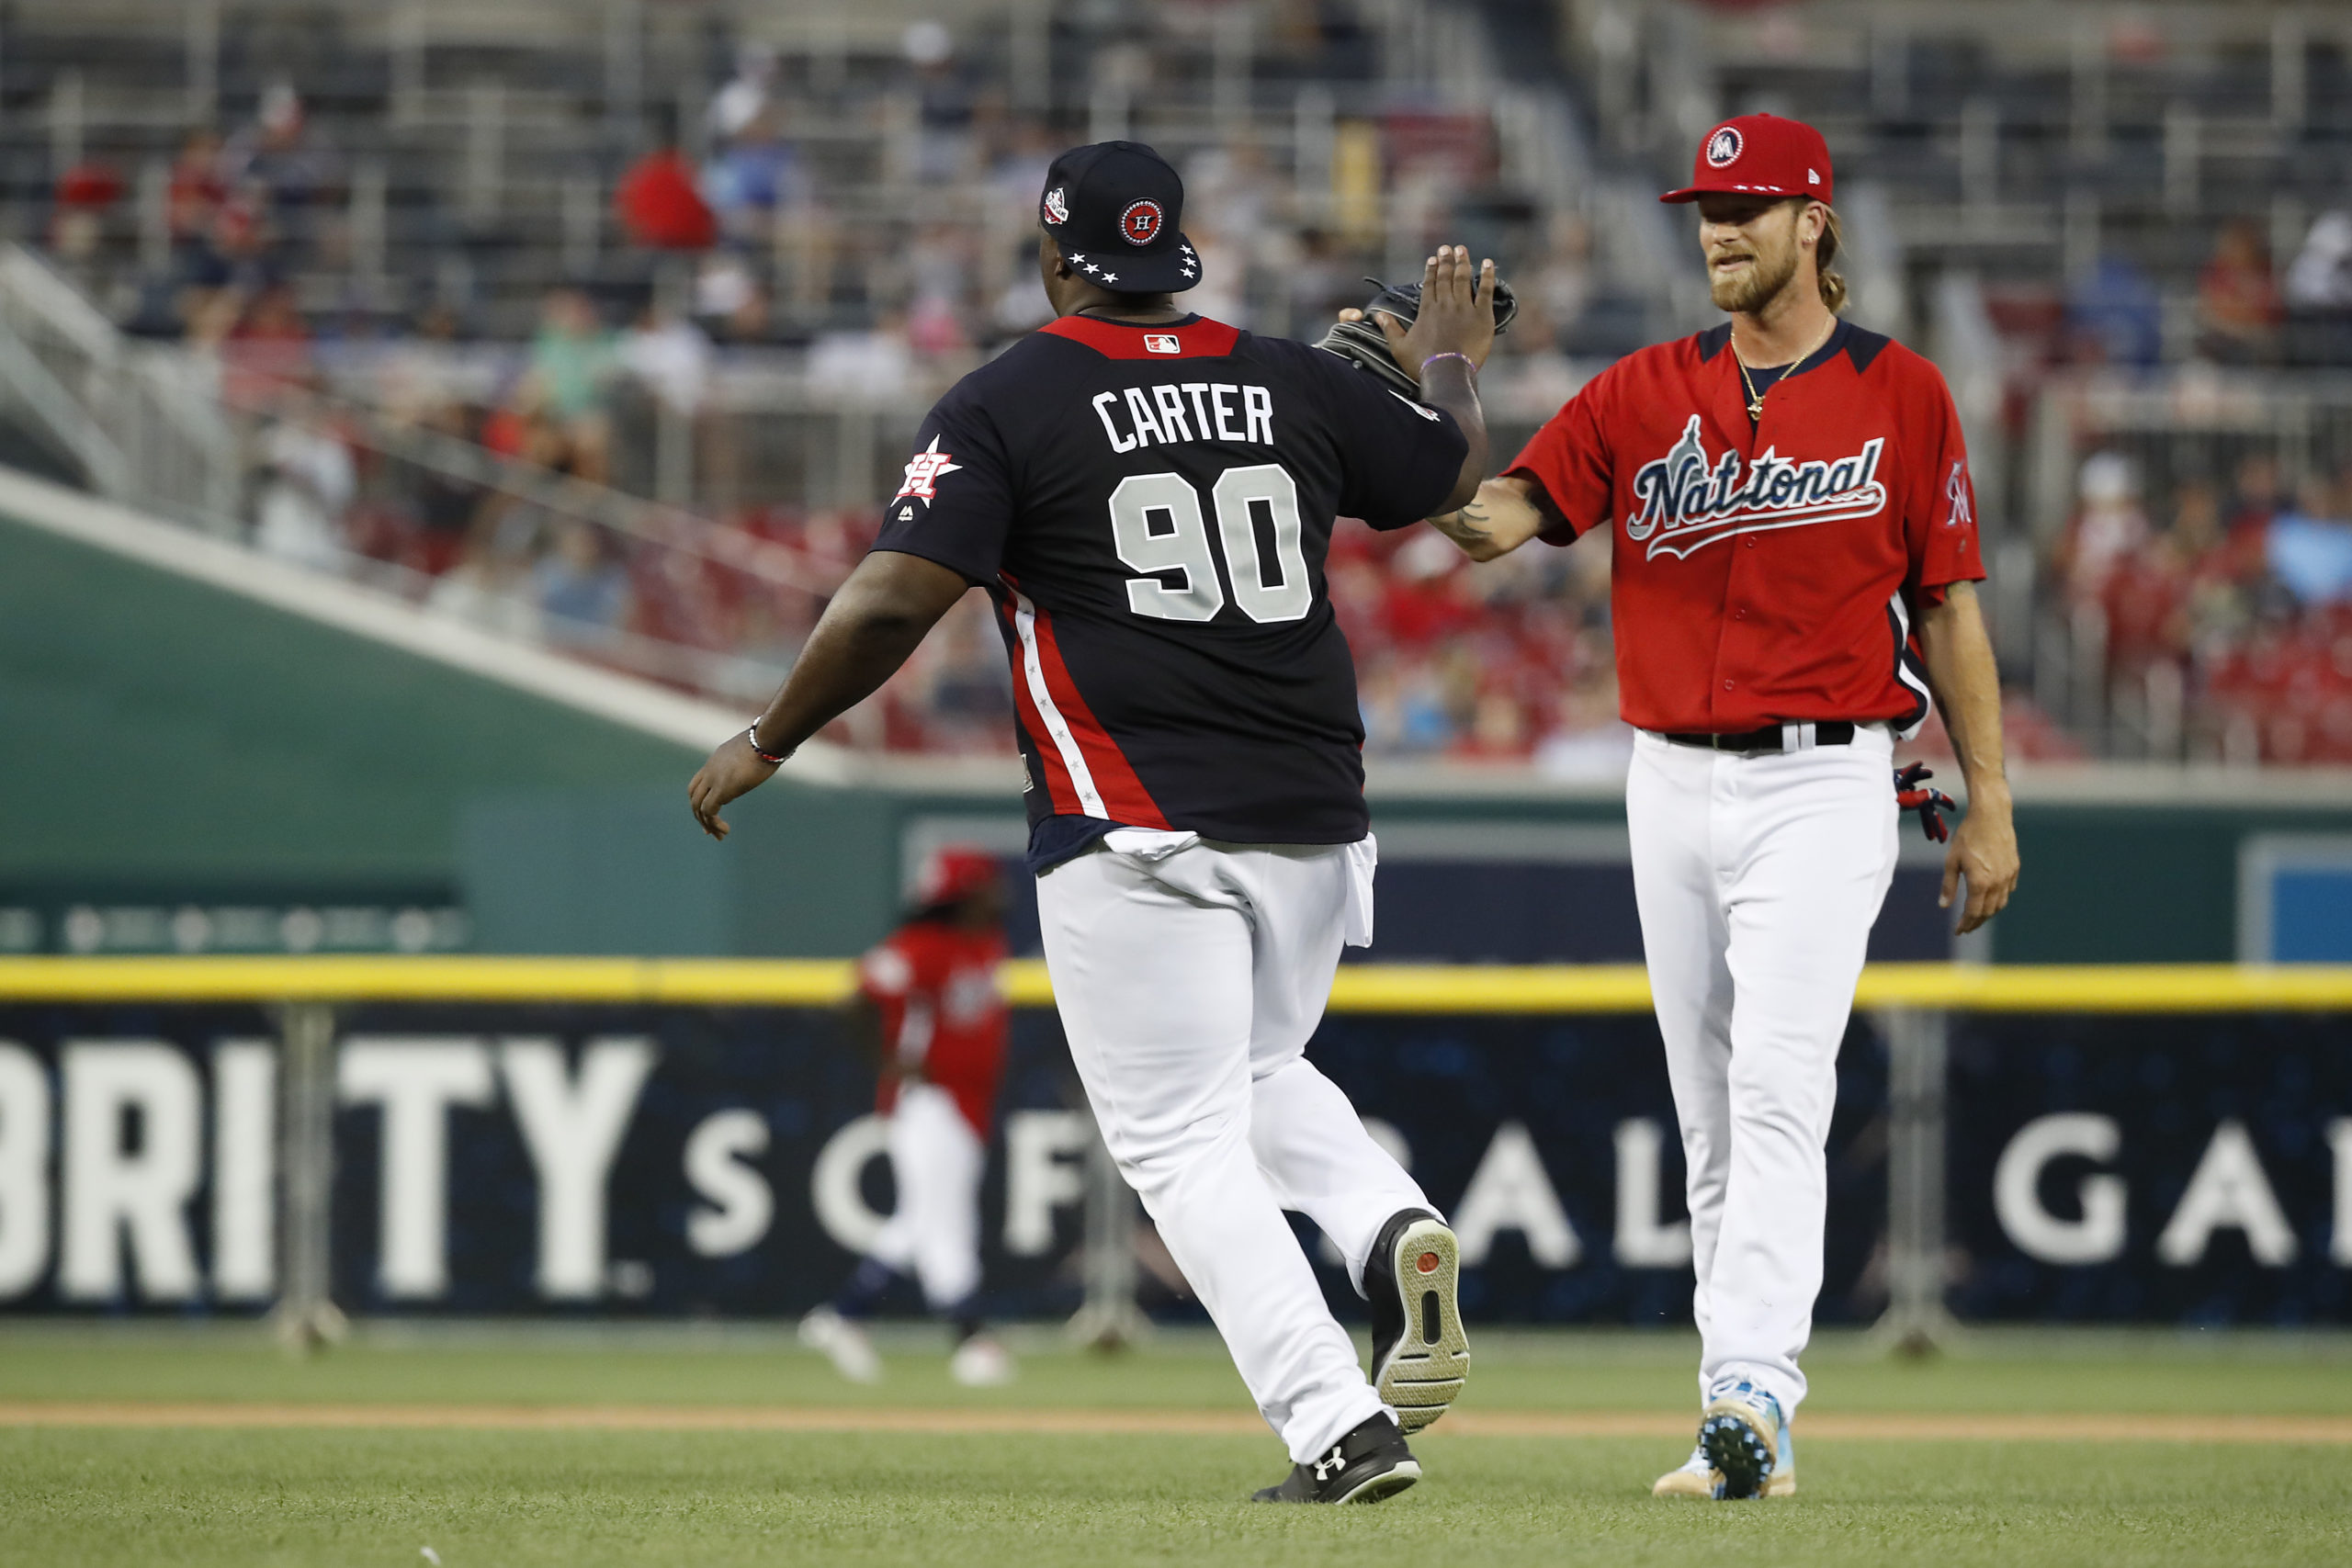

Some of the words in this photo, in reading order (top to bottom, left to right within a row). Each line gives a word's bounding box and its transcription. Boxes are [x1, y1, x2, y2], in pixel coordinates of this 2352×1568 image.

[1711, 134, 1735, 159] M
[1133, 215, 1151, 231] H
[1091, 382, 1274, 454] CARTER
[896, 452, 953, 500] H
[1625, 436, 1886, 541] National
[1108, 463, 1313, 624] 90
[1993, 1112, 2352, 1268] GA
